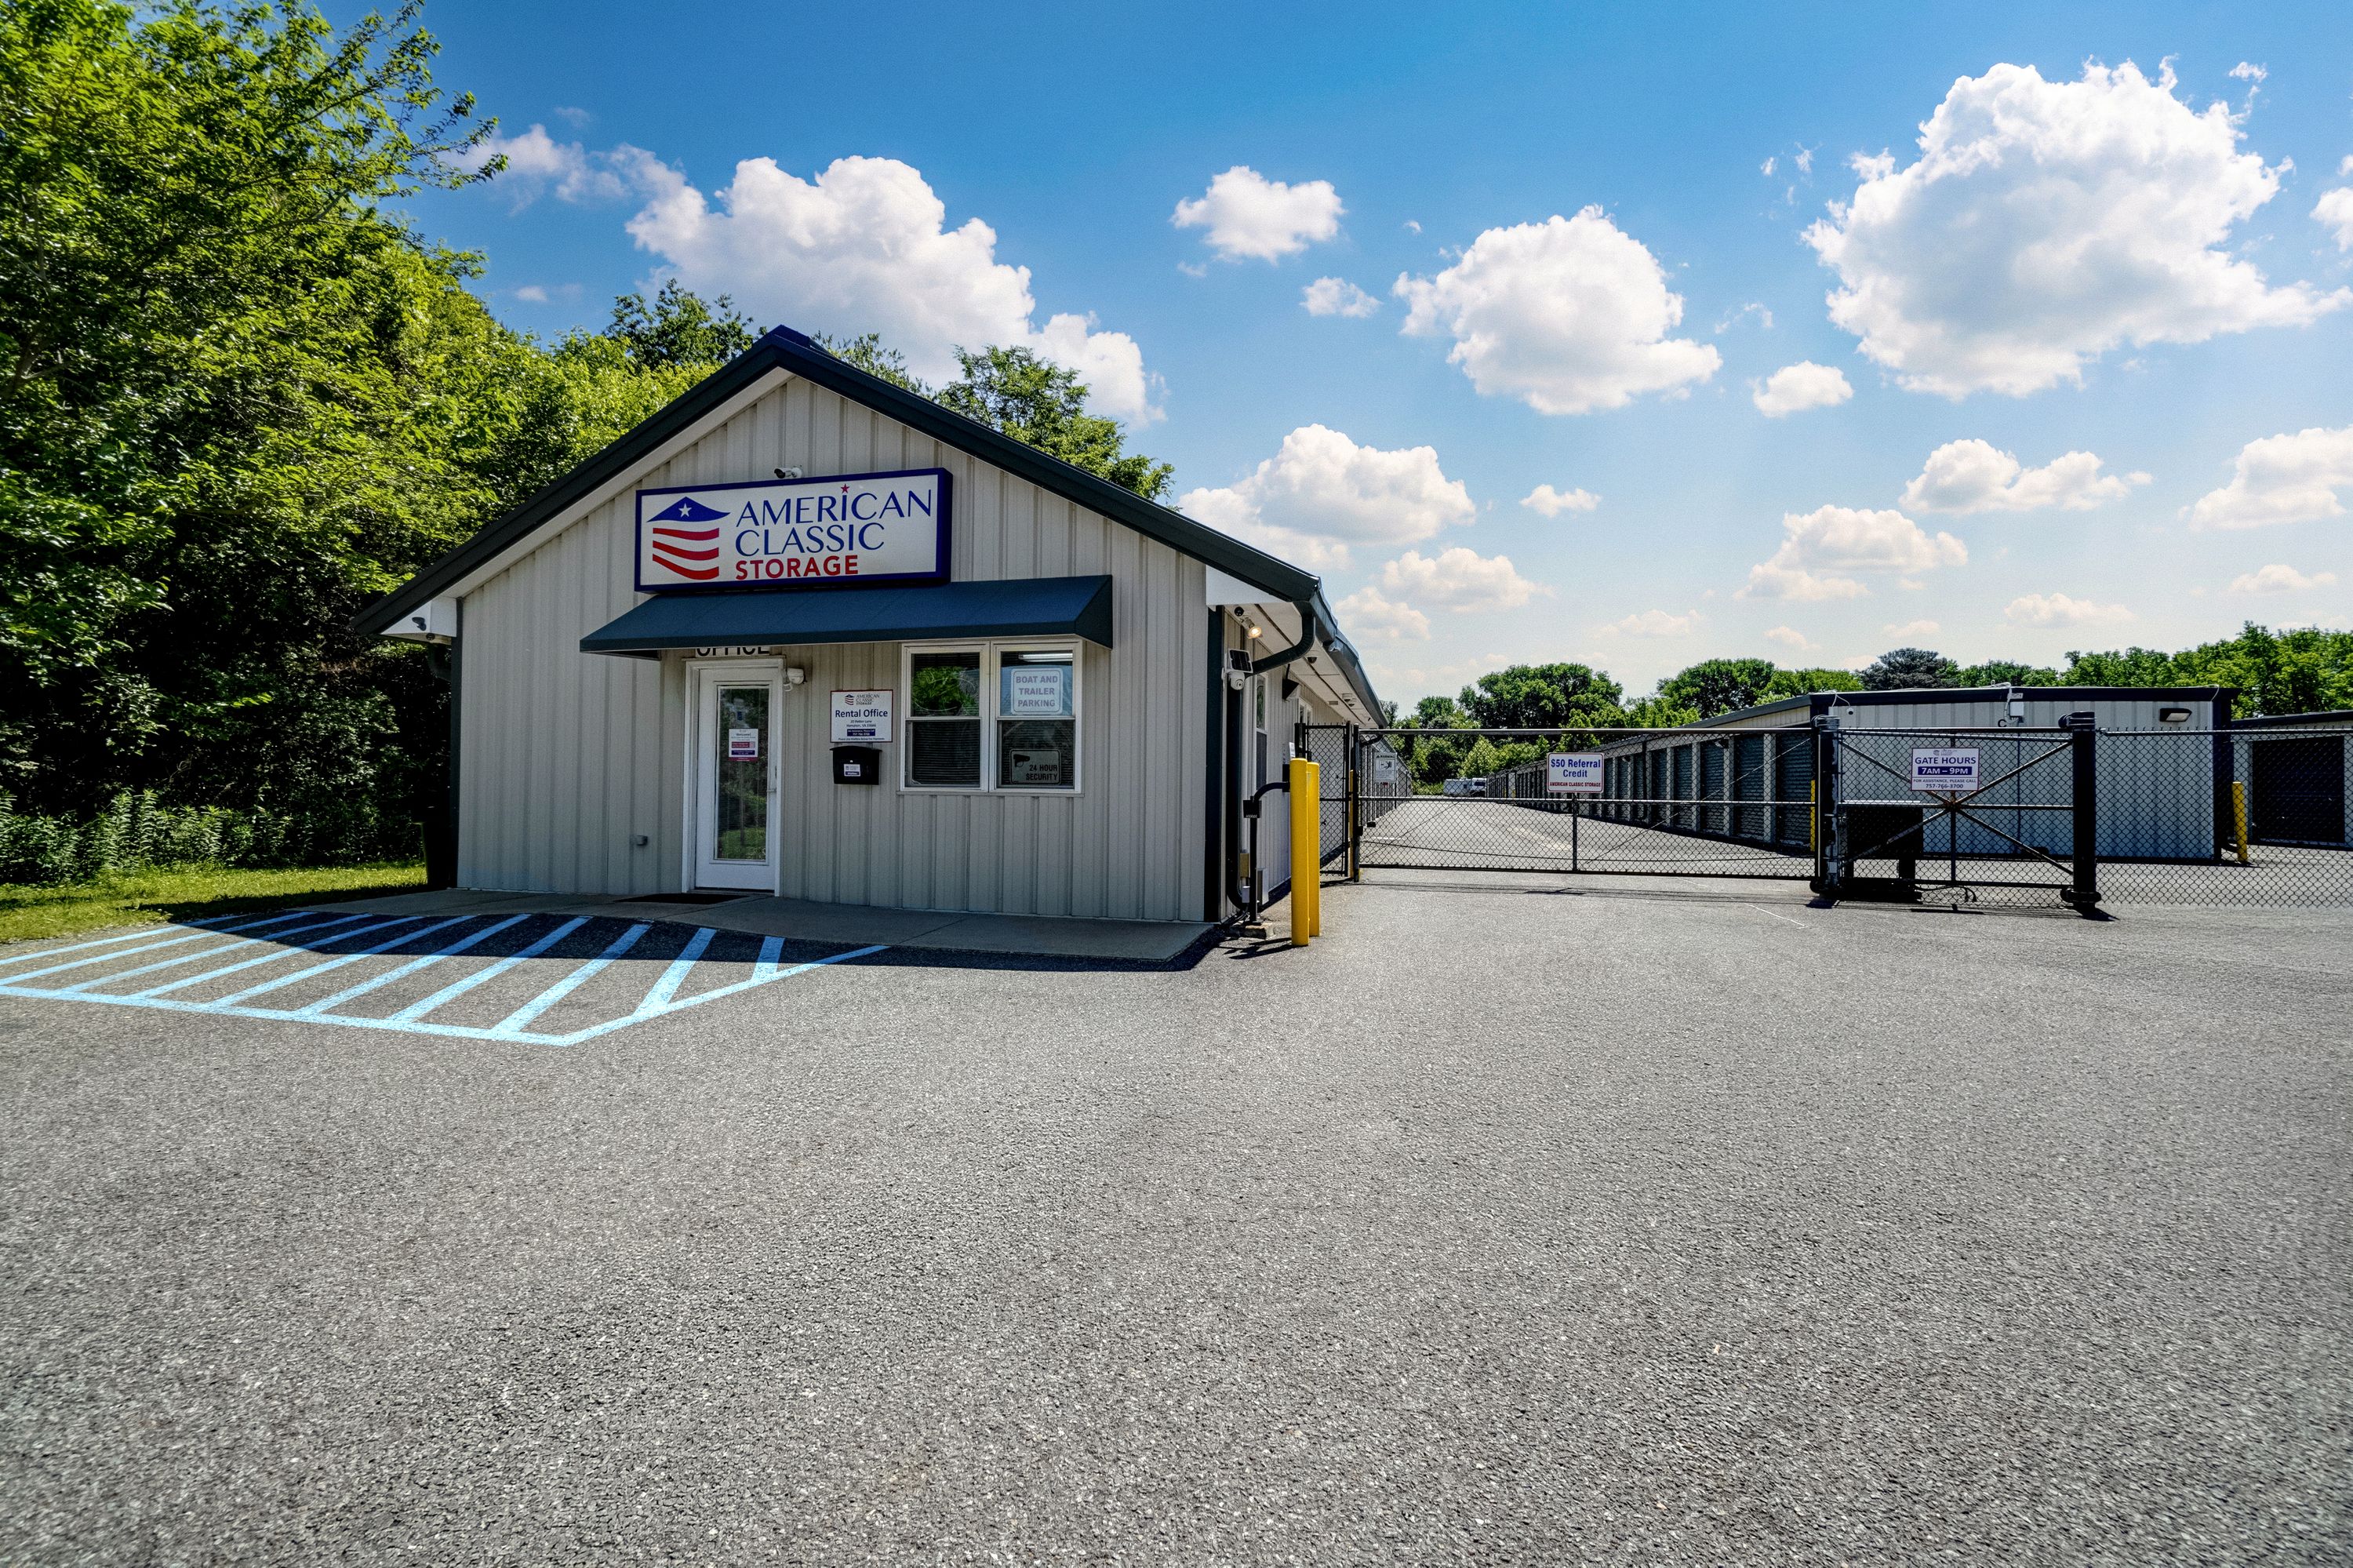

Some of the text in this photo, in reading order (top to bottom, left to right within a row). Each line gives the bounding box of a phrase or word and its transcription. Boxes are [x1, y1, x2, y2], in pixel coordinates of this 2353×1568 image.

[736, 489, 932, 527] AMERICAN
[736, 522, 885, 557] CLASSIC
[736, 555, 859, 580] STORAGE
[835, 708, 888, 718] Rental Office
[1551, 759, 1600, 768] $50 Referral
